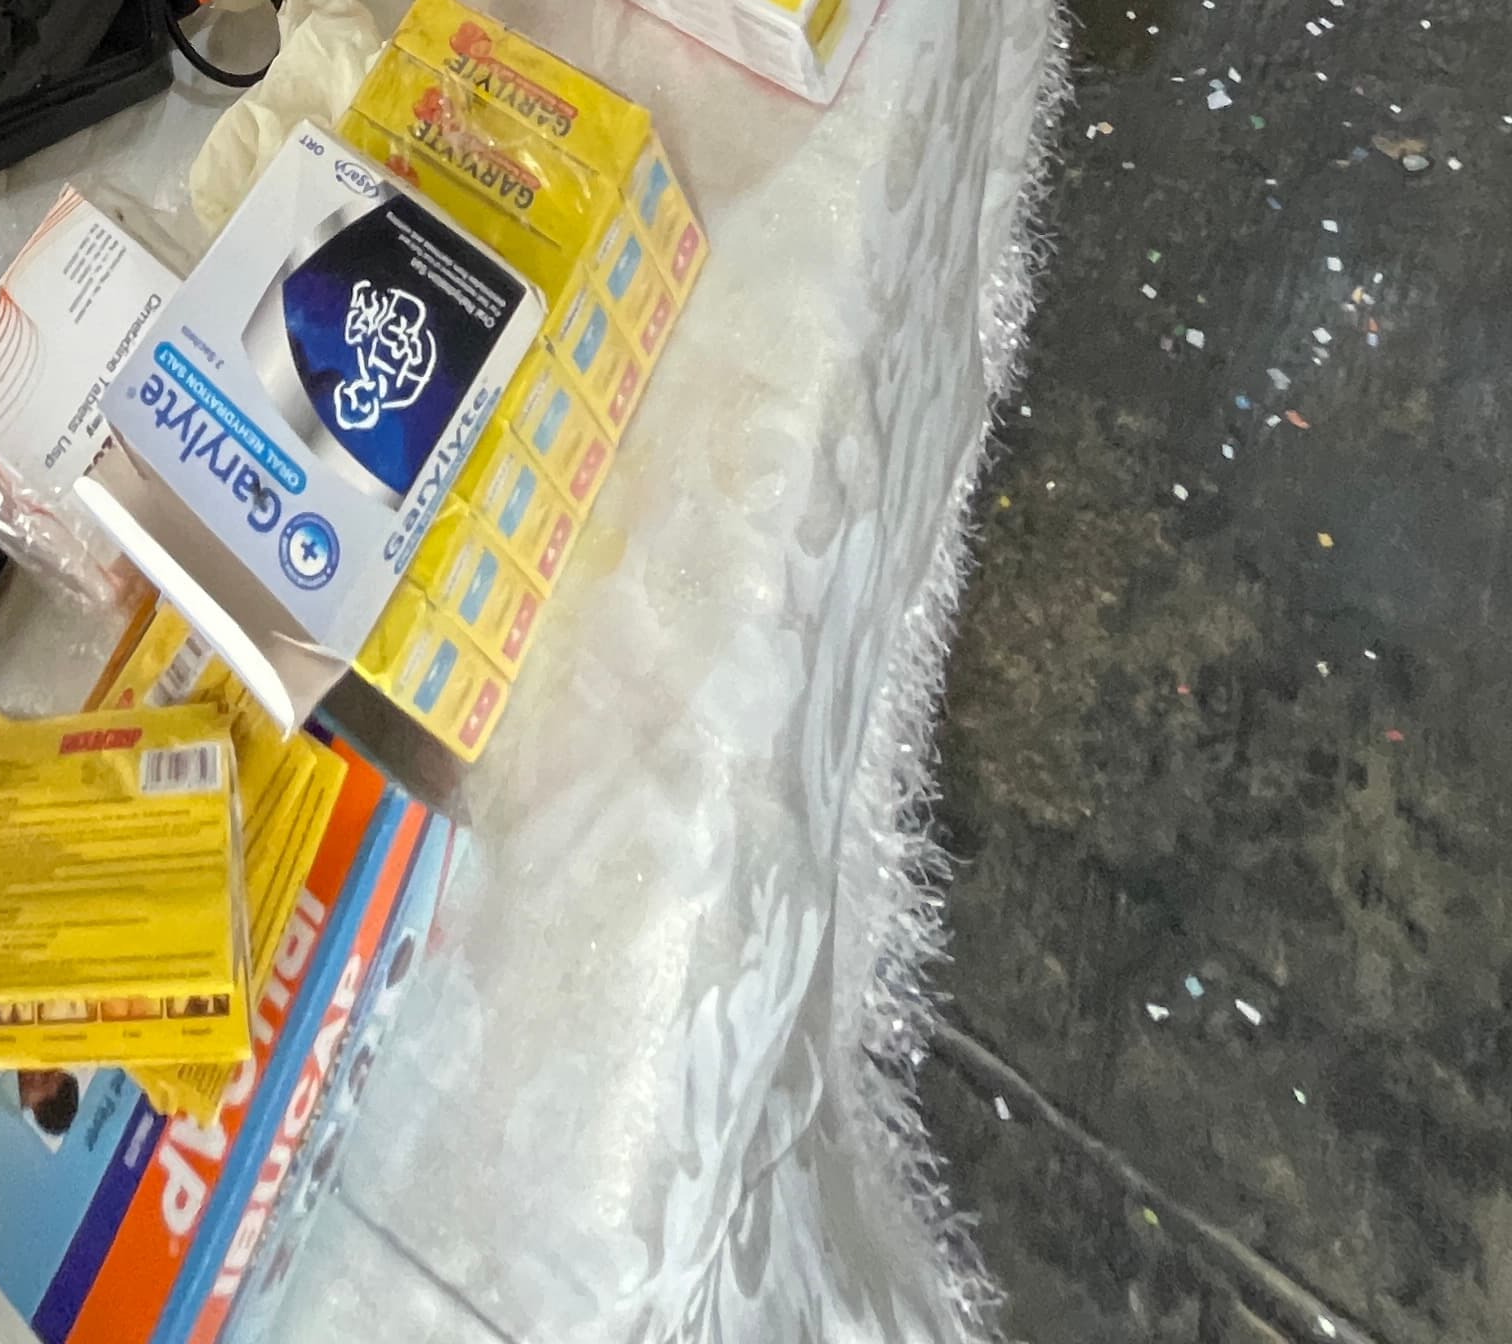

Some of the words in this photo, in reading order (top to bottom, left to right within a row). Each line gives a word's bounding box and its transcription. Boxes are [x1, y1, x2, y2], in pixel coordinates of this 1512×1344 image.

[445, 53, 573, 138] GARYLYTE
[299, 134, 325, 158] ORT
[337, 162, 378, 198] Agary
[408, 121, 536, 211] GARYLYTE
[109, 293, 163, 374] Cimetidine
[472, 307, 497, 330] Oral
[158, 348, 190, 379] SALT
[68, 378, 112, 442] Tablets
[182, 372, 270, 453] REHYDRATION
[44, 434, 71, 468] Usp
[137, 372, 283, 534] Garylyte
[263, 449, 304, 487] ORAL
[385, 385, 487, 562] Garylyte
[213, 955, 361, 1298] IBUCAP
